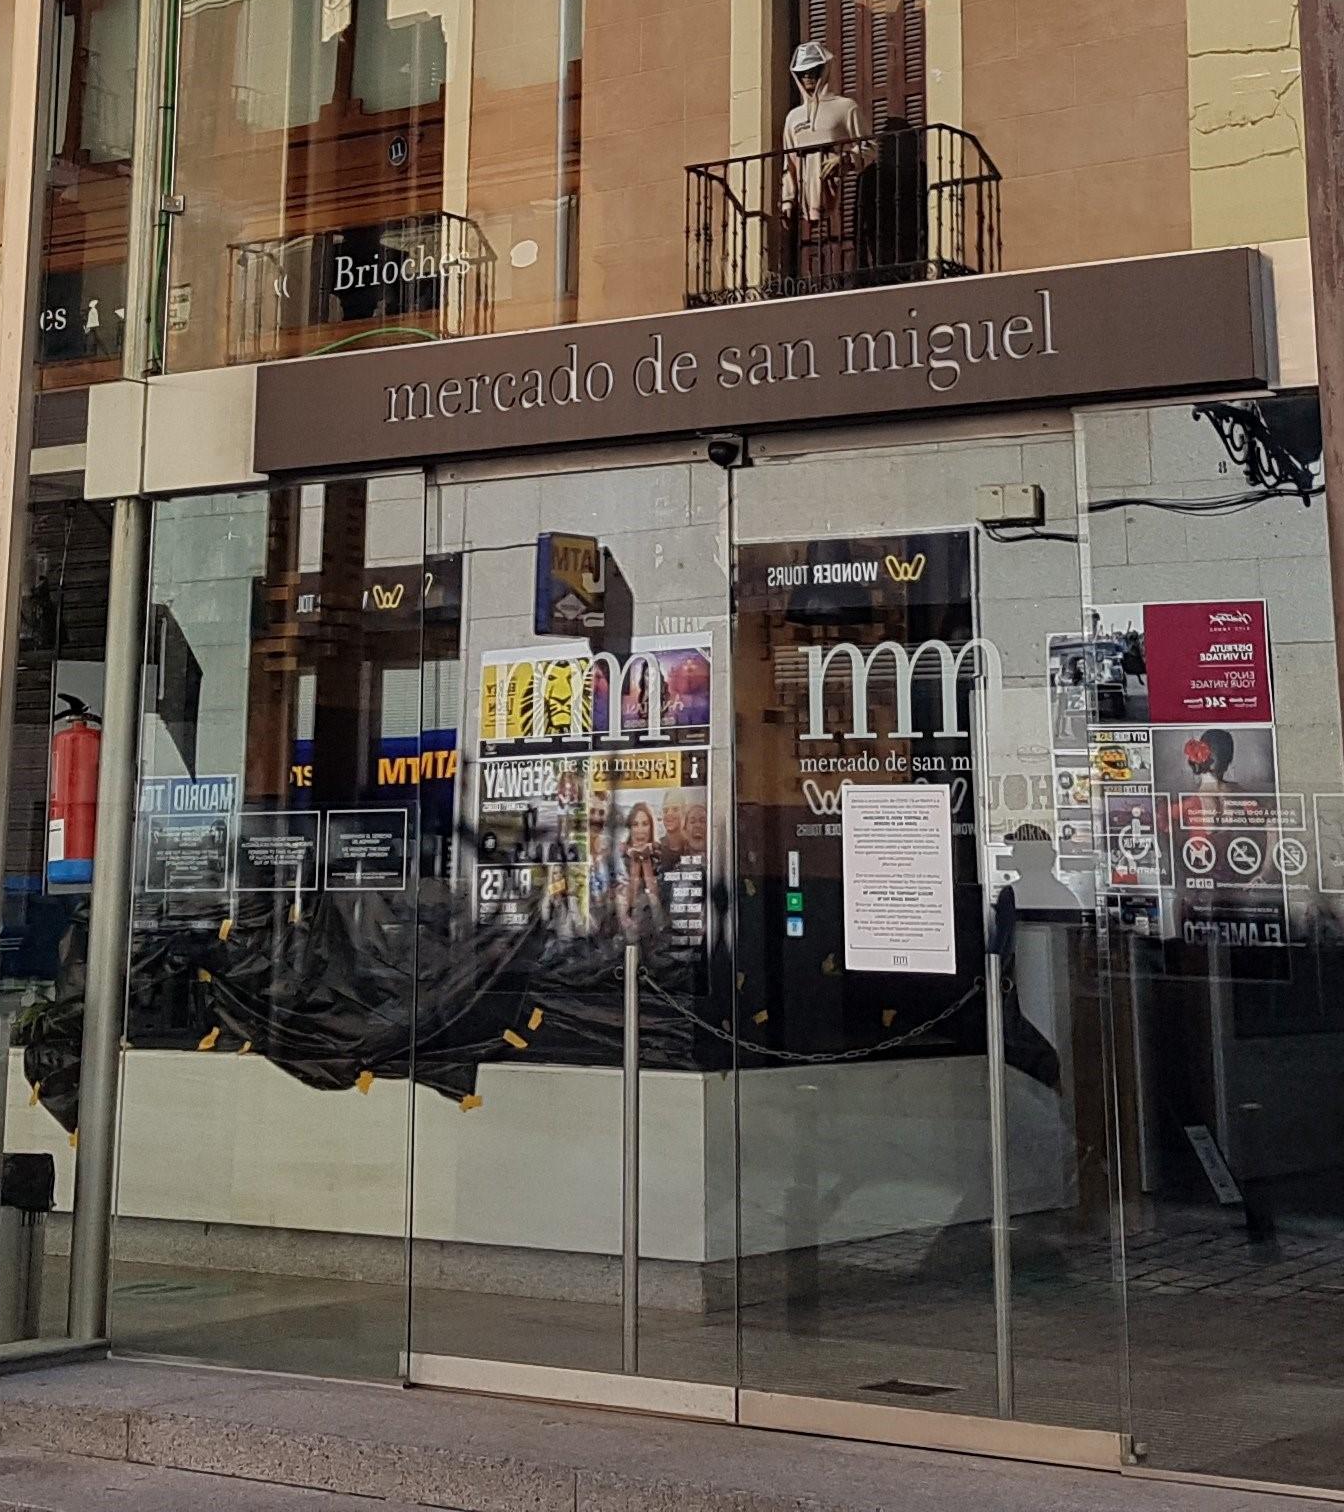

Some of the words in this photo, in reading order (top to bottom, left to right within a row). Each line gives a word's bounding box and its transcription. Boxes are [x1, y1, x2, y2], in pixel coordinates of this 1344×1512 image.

[333, 243, 471, 292] Brioches
[383, 343, 616, 424] mercado
[633, 331, 698, 400] de
[717, 336, 821, 389] san
[839, 288, 1060, 392] miguel
[799, 751, 881, 773] mercado
[885, 750, 907, 772] de
[912, 756, 945, 772] san
